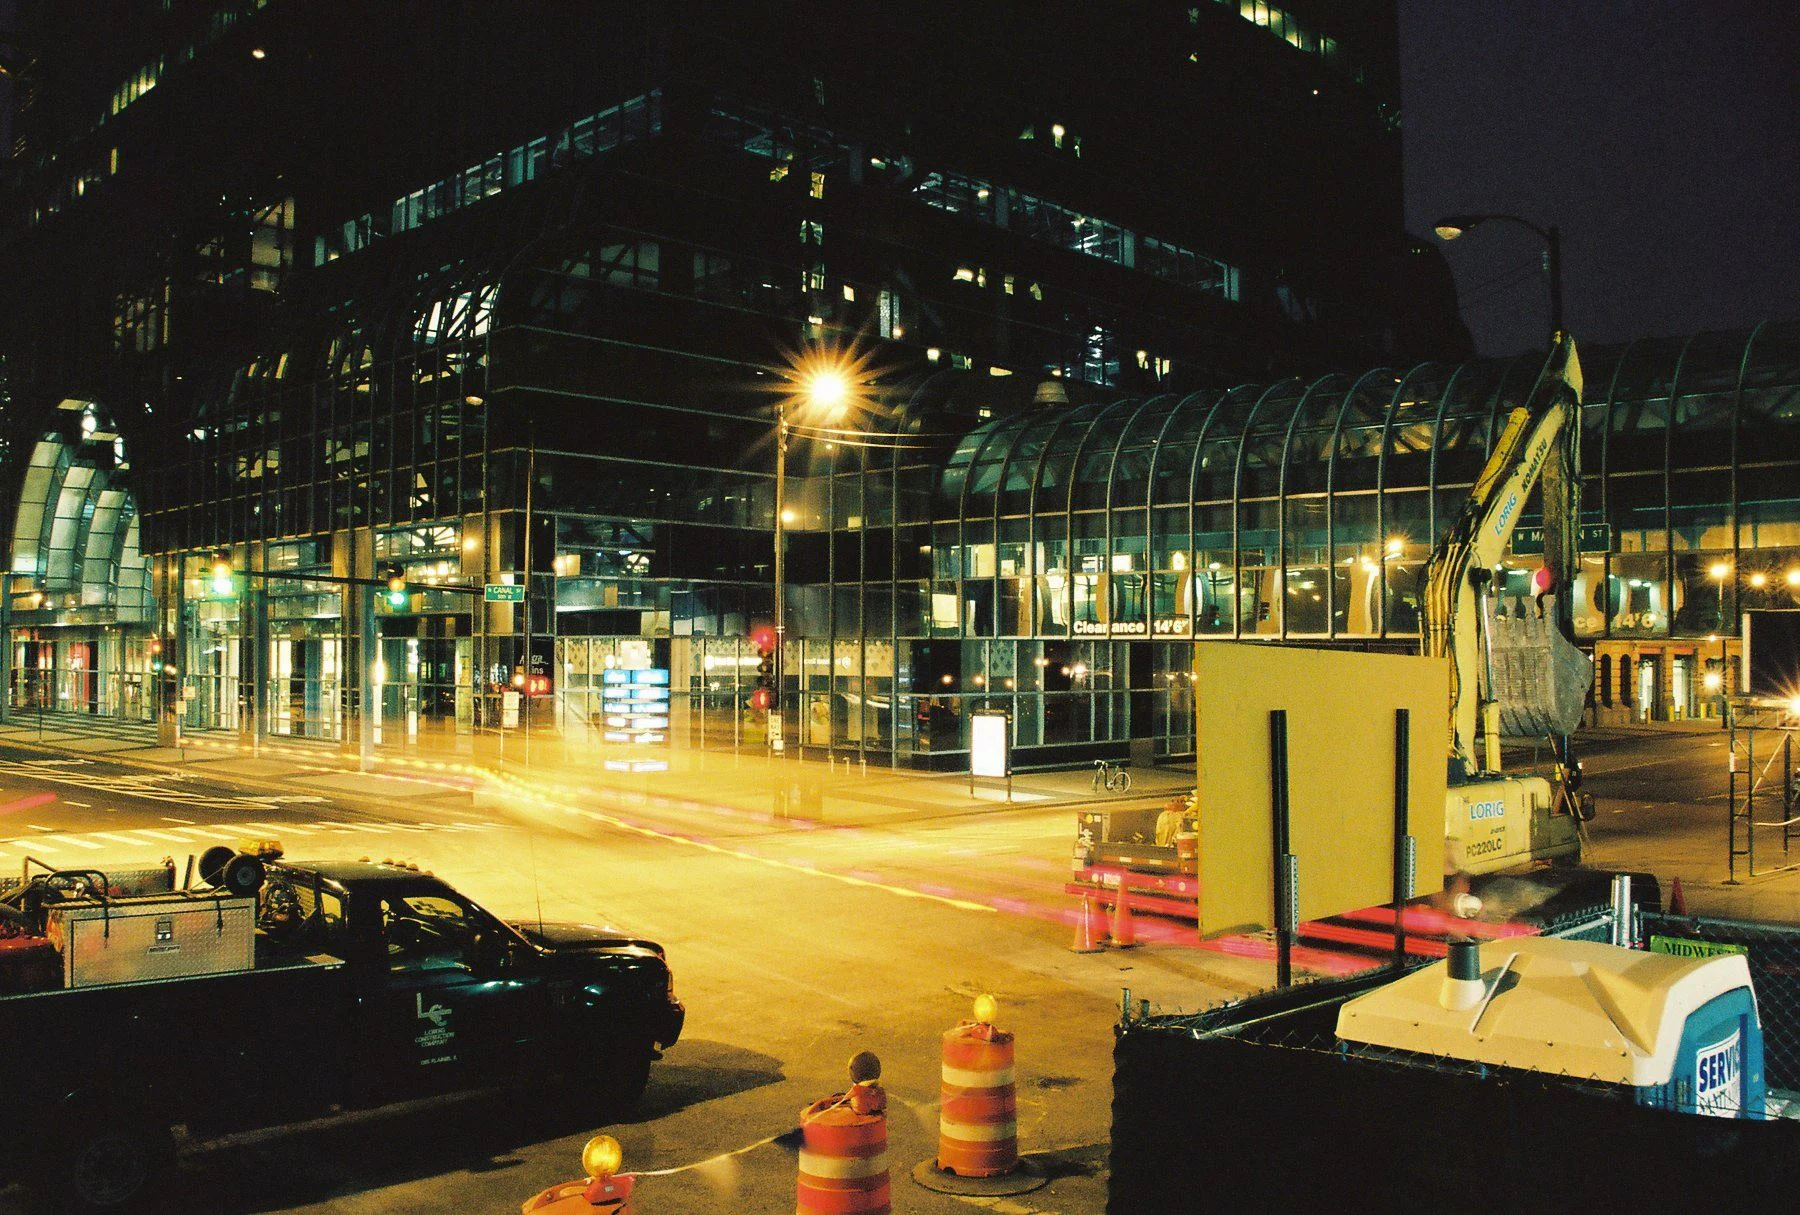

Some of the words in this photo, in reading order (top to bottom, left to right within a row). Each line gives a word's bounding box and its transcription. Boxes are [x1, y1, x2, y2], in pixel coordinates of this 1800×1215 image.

[1521, 438, 1547, 493] KOMATSU
[1494, 492, 1517, 536] LORIG
[1591, 529, 1603, 538] ST
[493, 586, 514, 595] CANAL
[1073, 620, 1146, 634] Clearance
[1469, 800, 1505, 820] LORIG
[1466, 838, 1503, 858] PC220LC
[1663, 941, 1732, 959] MIDWE
